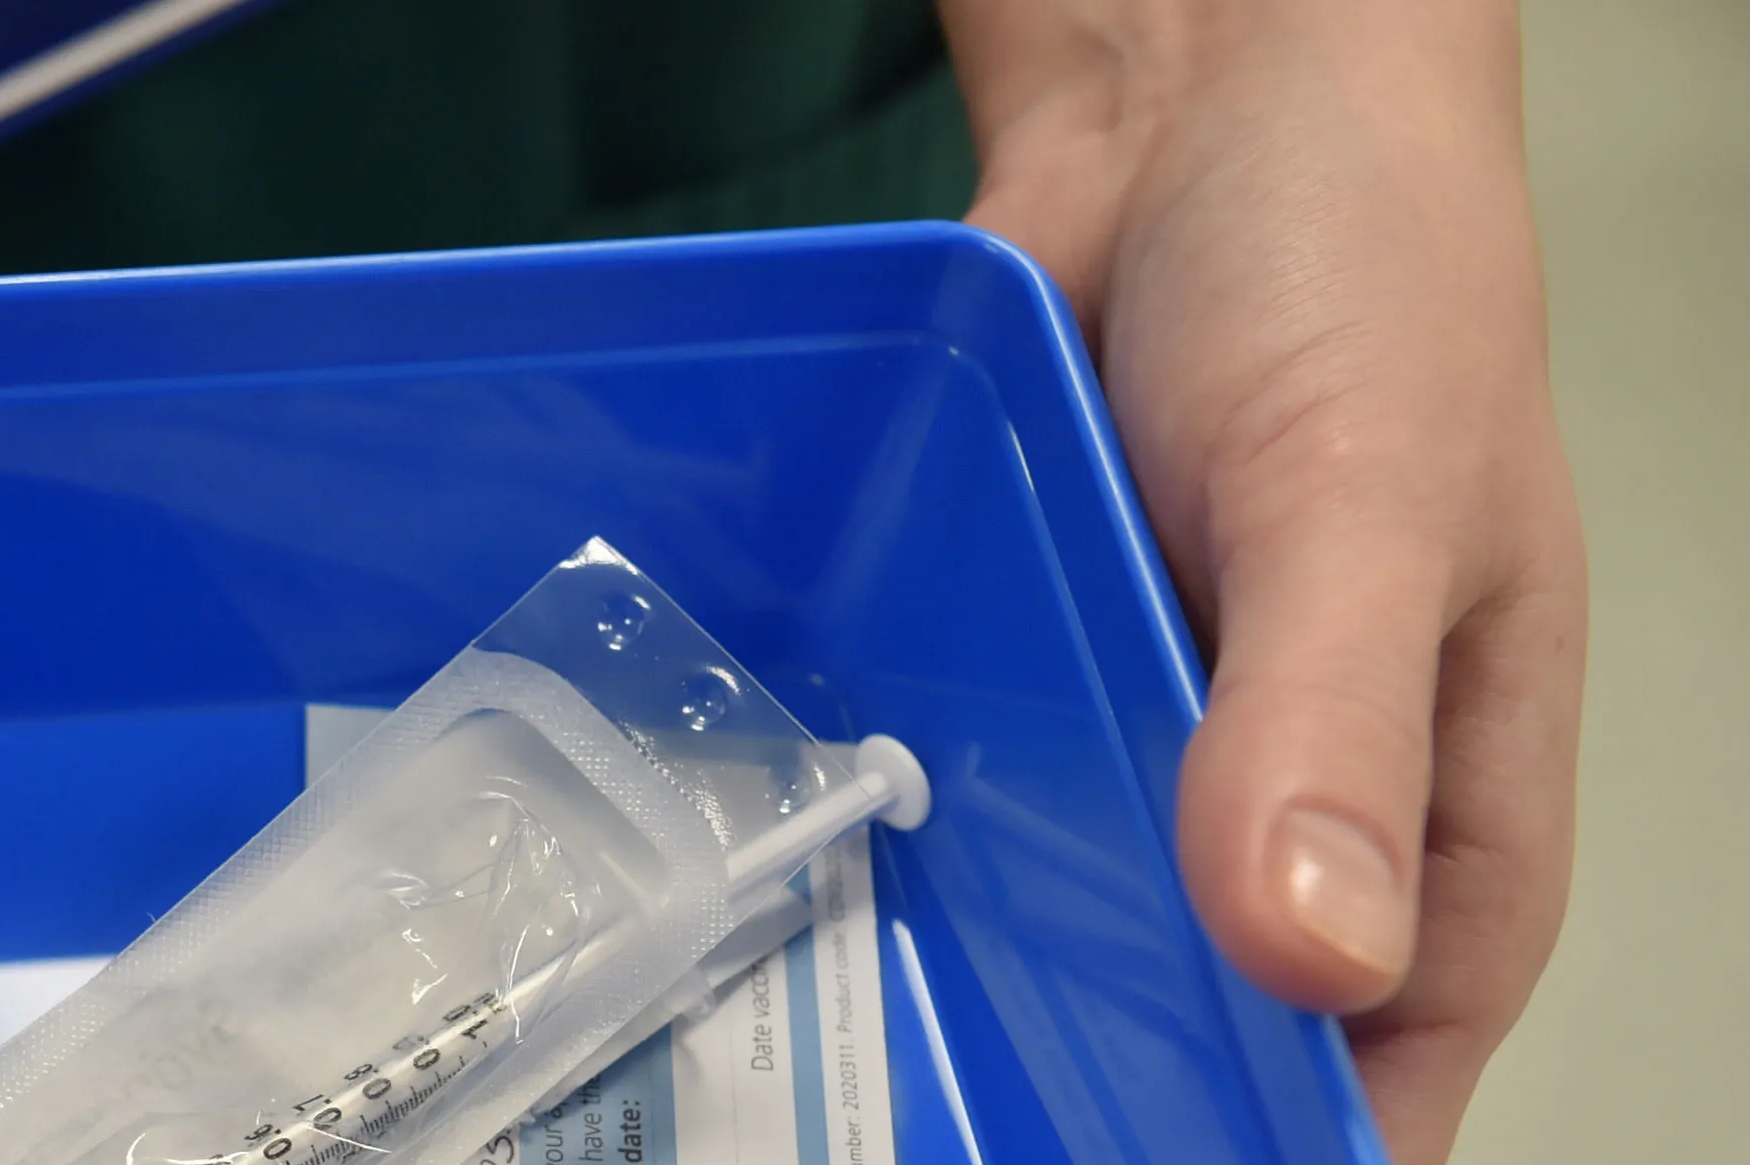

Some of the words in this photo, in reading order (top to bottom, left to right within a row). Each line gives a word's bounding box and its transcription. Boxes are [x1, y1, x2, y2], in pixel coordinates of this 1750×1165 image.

[834, 972, 855, 1034] Product
[751, 1023, 774, 1072] Date
[344, 1062, 392, 1100] 0.8
[292, 1093, 343, 1132] 0.7
[617, 1099, 646, 1163] date:
[244, 1123, 292, 1161] 0.6
[579, 1112, 604, 1165] have
